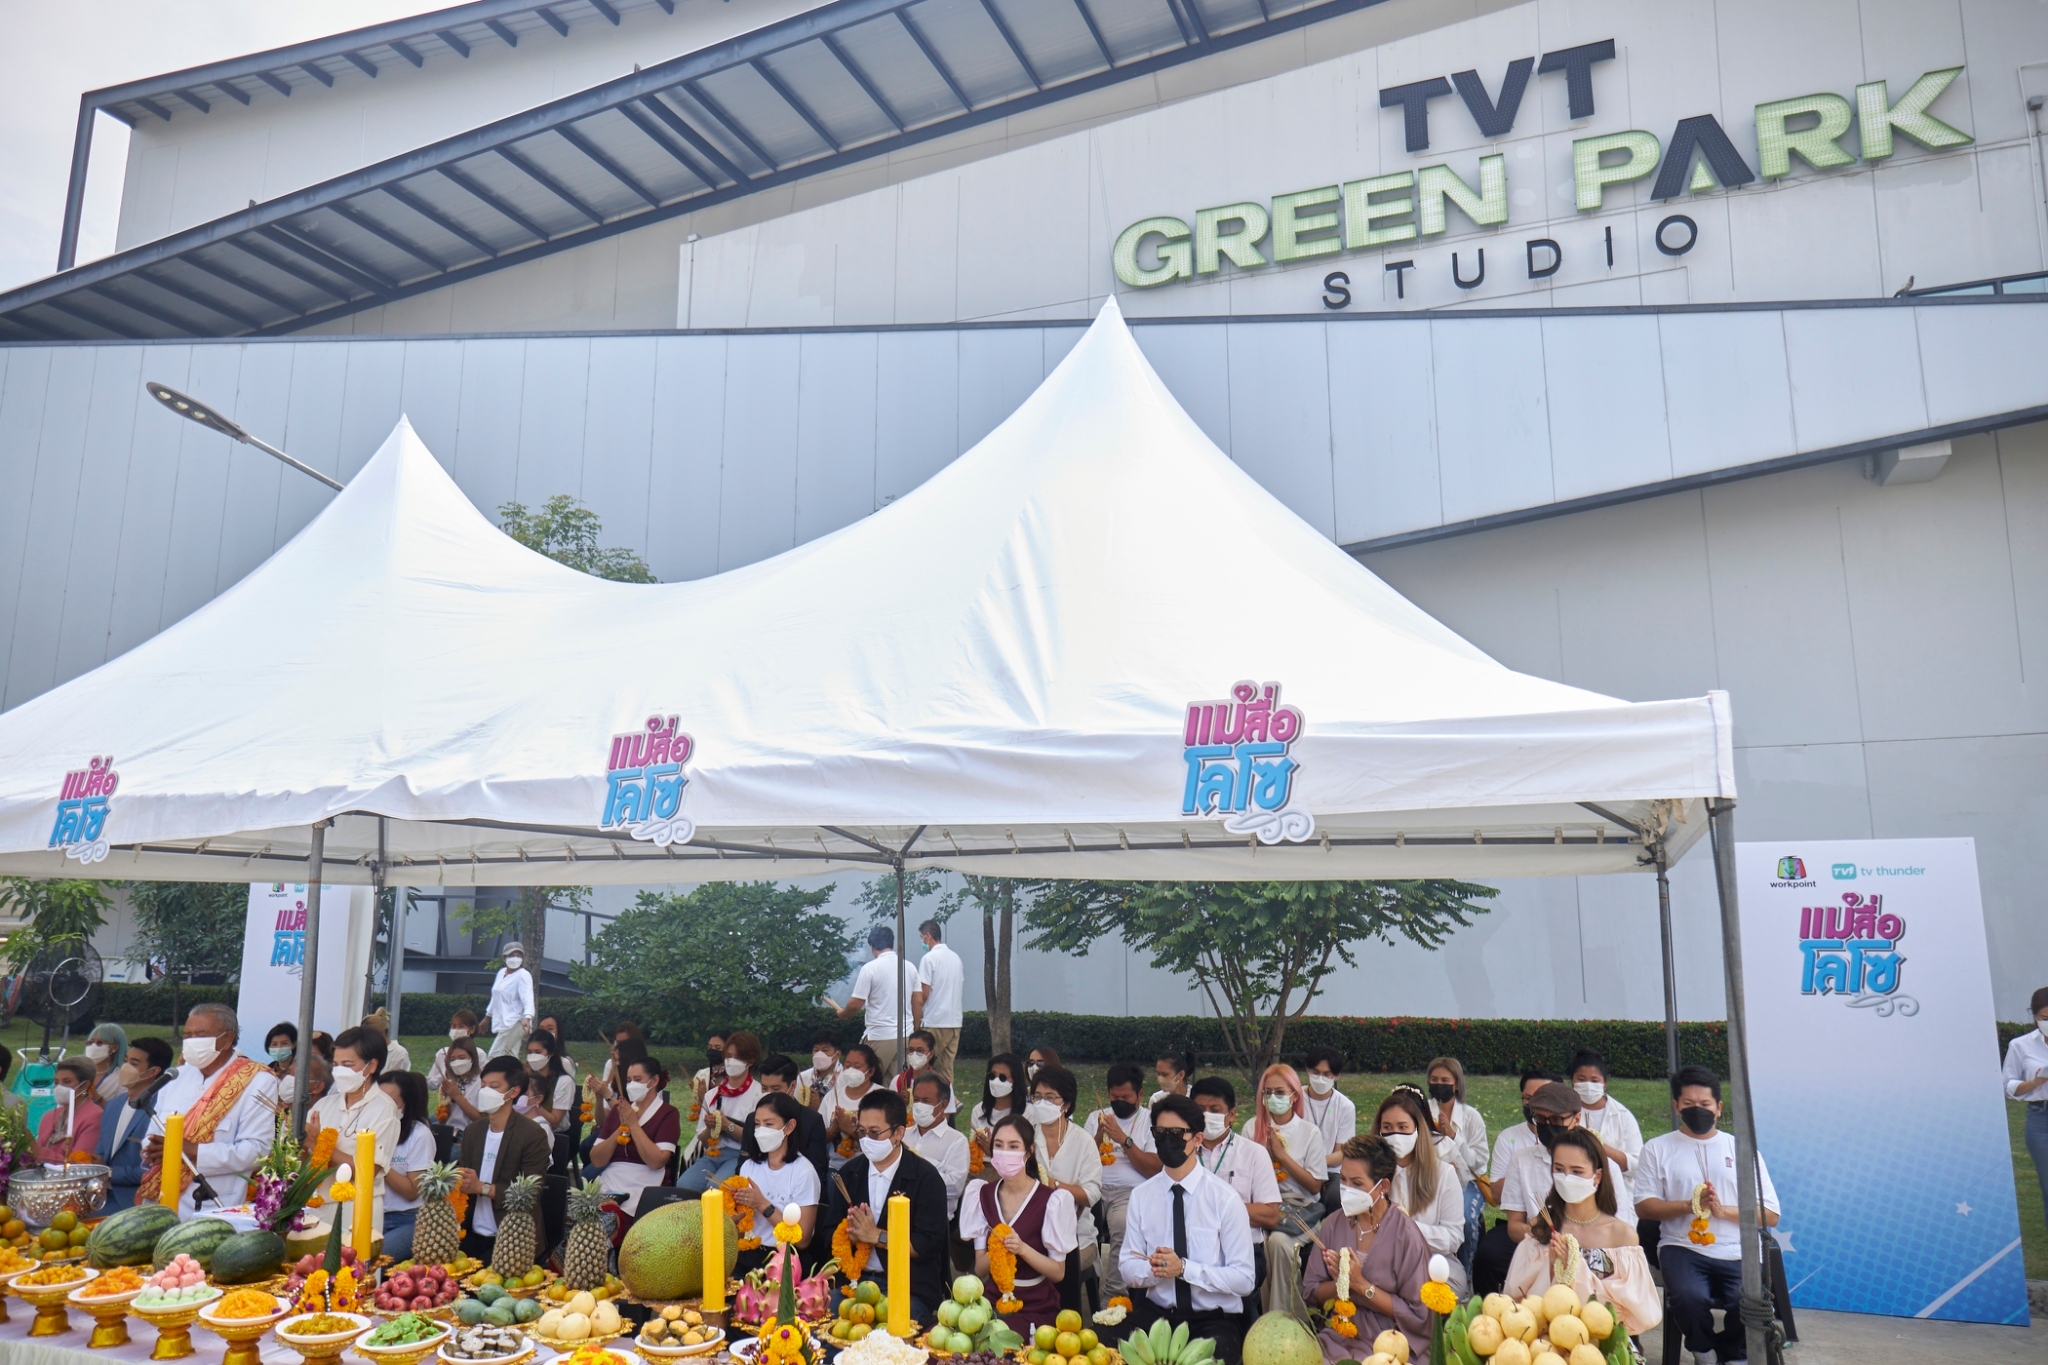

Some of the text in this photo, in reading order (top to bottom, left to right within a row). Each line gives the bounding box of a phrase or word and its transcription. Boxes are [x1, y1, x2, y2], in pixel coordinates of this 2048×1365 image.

[1379, 38, 1616, 153] TVT
[1111, 65, 1975, 290] GREEN PARK
[1322, 214, 1698, 310] STUDIO
[601, 763, 689, 827] โลโซ
[1181, 742, 1300, 817] โลโซ
[48, 796, 111, 848] โลโซ
[1769, 880, 1817, 889] workpoint
[1860, 867, 1872, 877] tv
[1876, 865, 1926, 877] thunder
[1799, 939, 1907, 996] โลโซ
